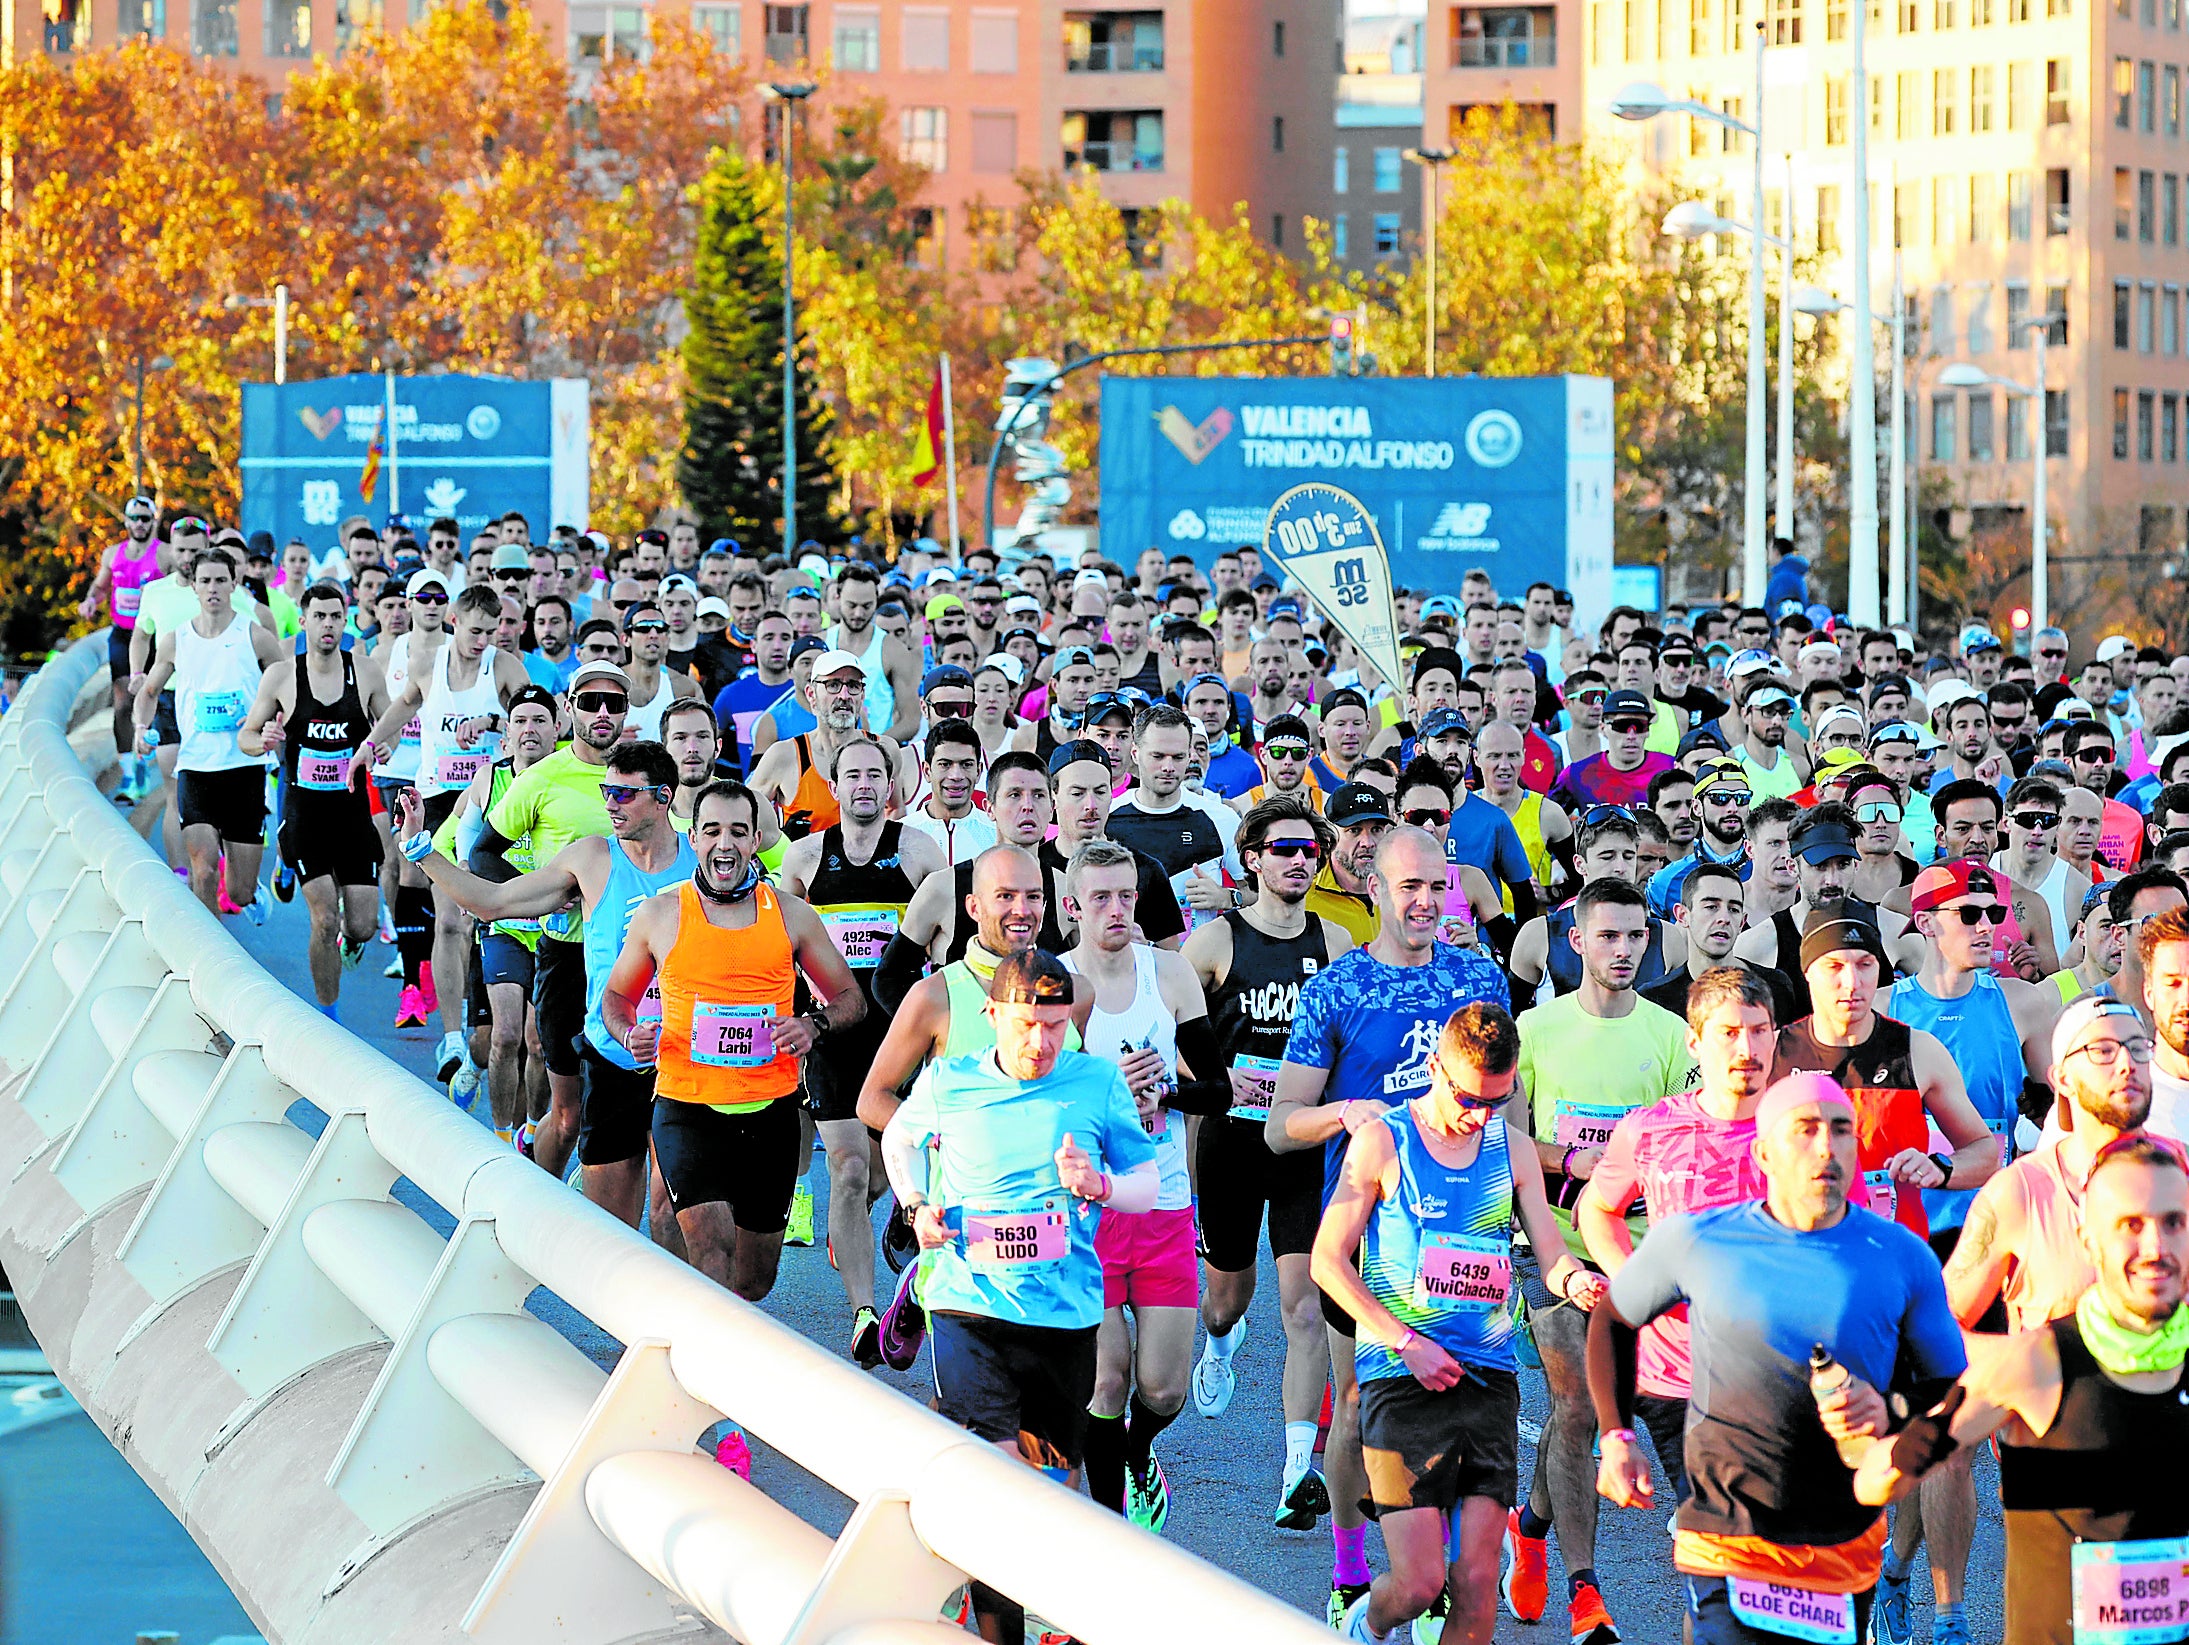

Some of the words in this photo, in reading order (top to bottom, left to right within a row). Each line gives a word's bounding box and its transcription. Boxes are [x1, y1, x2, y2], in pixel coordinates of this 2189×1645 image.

[1241, 406, 1372, 437] VALENCIA
[1240, 440, 1345, 468] TRINIDAD
[1345, 441, 1454, 470] ALFONSO
[307, 721, 349, 740] KICK
[315, 764, 338, 774] 4736
[452, 762, 477, 771] 5346
[312, 773, 340, 782] SVANE
[842, 931, 873, 943] 4925
[845, 945, 871, 956] Alec
[719, 1026, 753, 1040] 7064
[1252, 1026, 1281, 1035] Puresport
[718, 1041, 752, 1054] Larbi
[1390, 1075, 1408, 1089] 16
[994, 1226, 1036, 1241] 5630
[996, 1243, 1038, 1259] LUDO
[1450, 1261, 1490, 1280] 6439
[1425, 1276, 1504, 1300] ViviChacha
[2121, 1578, 2169, 1599] 6898
[1740, 1592, 1783, 1614] CLOE
[1789, 1601, 1845, 1628] CHARL
[2099, 1604, 2173, 1623] Marcos
